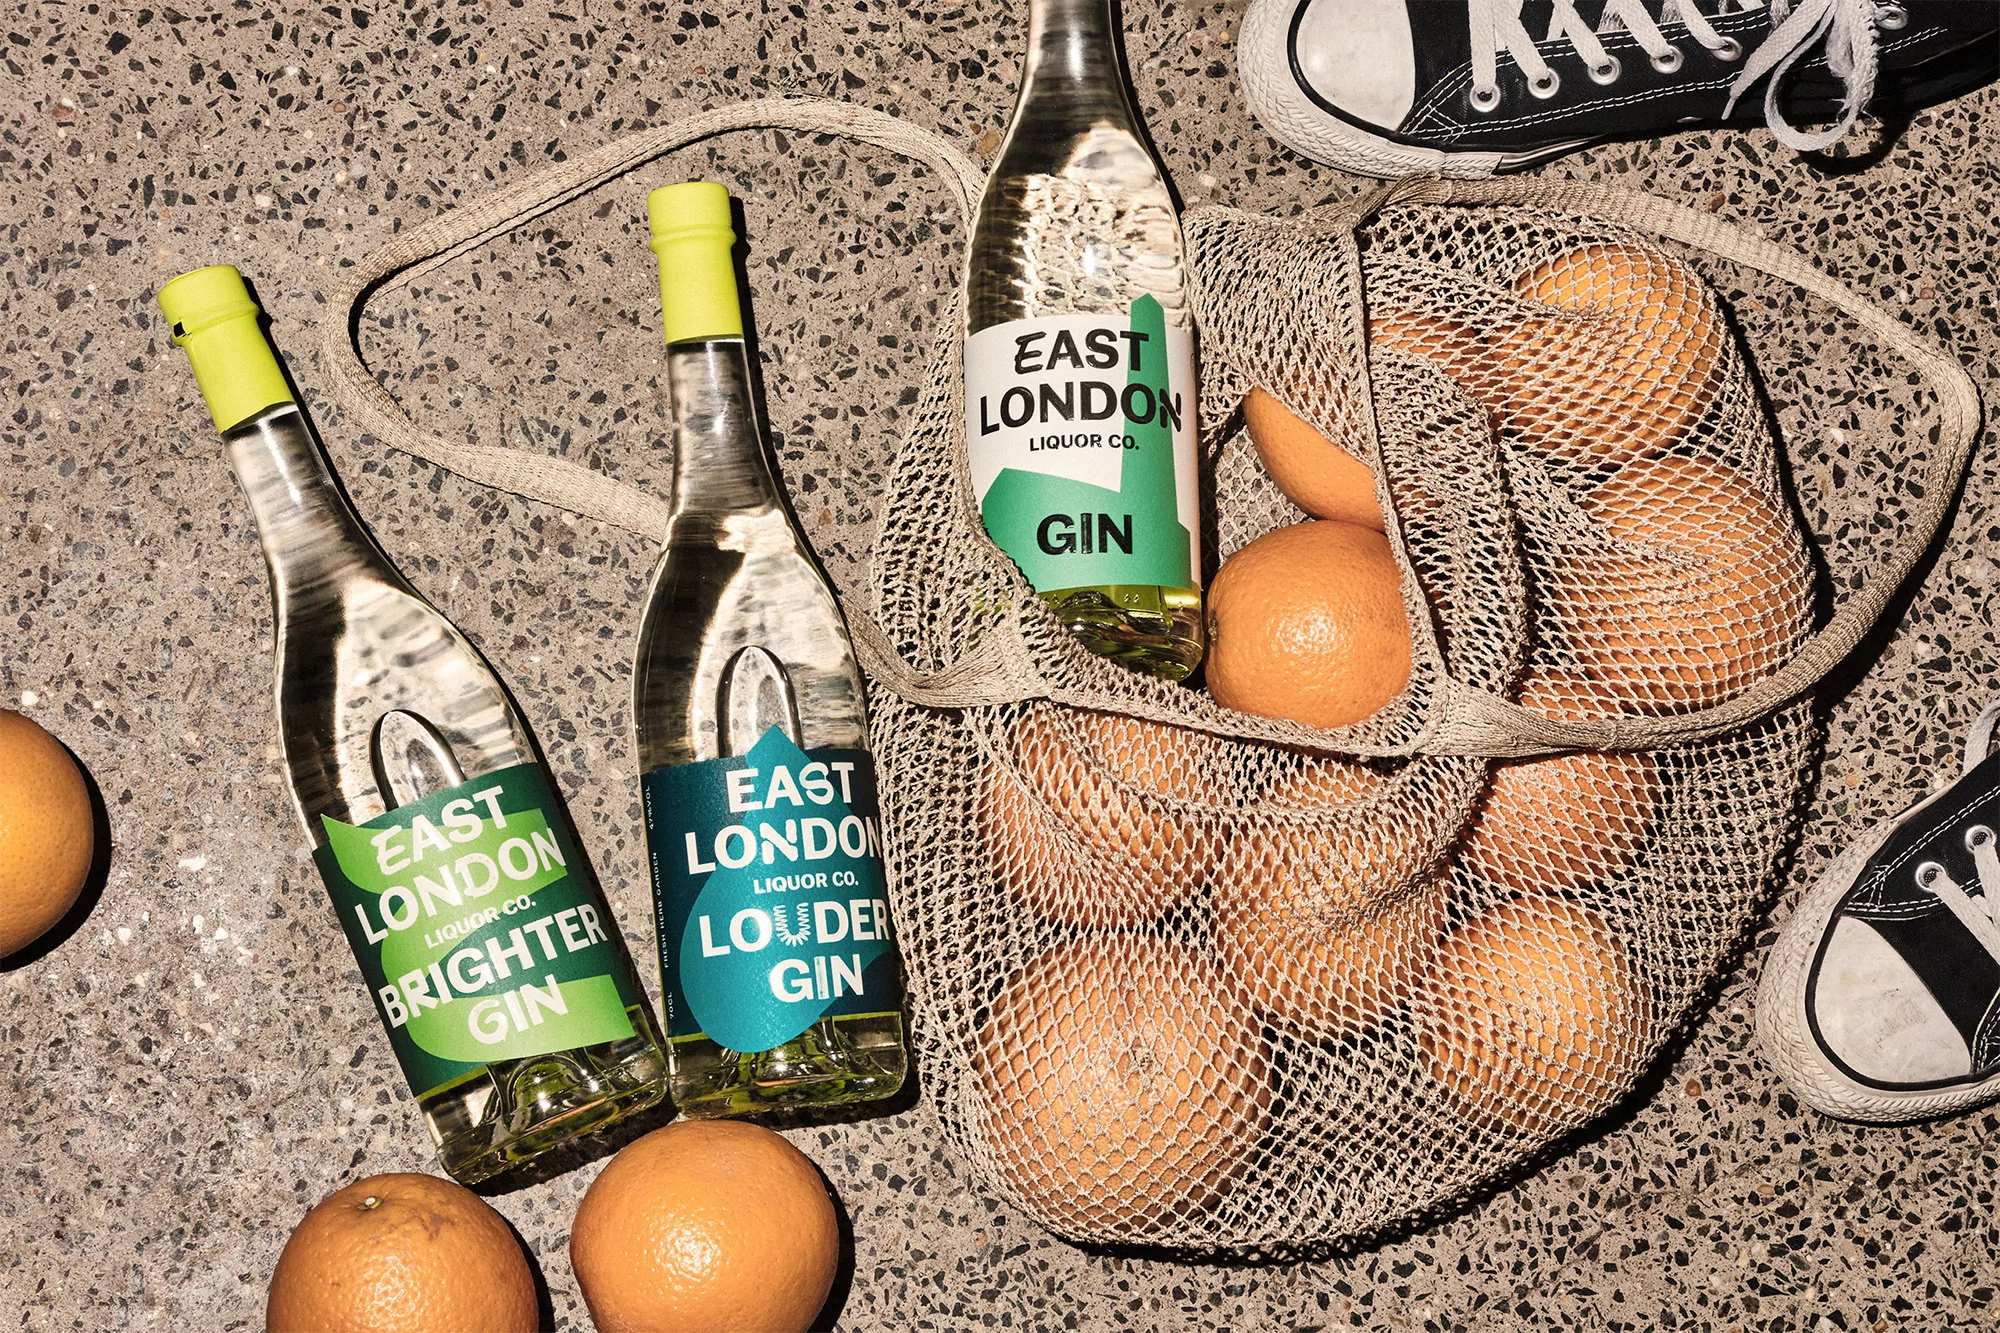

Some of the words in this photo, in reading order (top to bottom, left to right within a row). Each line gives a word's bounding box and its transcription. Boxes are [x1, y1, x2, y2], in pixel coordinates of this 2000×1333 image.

[1014, 328, 1150, 375] EAST
[980, 380, 1182, 437] LONDON
[1029, 433, 1102, 452] LIQUOR
[1107, 433, 1140, 451] CO.
[1036, 512, 1133, 556] GIN
[725, 761, 855, 813] EAST
[370, 785, 508, 876] EAST
[684, 814, 883, 876] LONDON
[354, 828, 567, 946] LONDON
[652, 852, 662, 896] GARDEN
[753, 873, 828, 895] LIQUOR
[831, 870, 859, 888] CO.
[423, 909, 501, 949] LIQUOR
[502, 894, 537, 916] CO.
[657, 901, 665, 929] HERB
[699, 898, 891, 958] LOUDER
[378, 903, 608, 1029] BRIGHTER
[661, 934, 669, 968] FRESH
[768, 953, 865, 1004] GIN
[466, 973, 569, 1045] GIN
